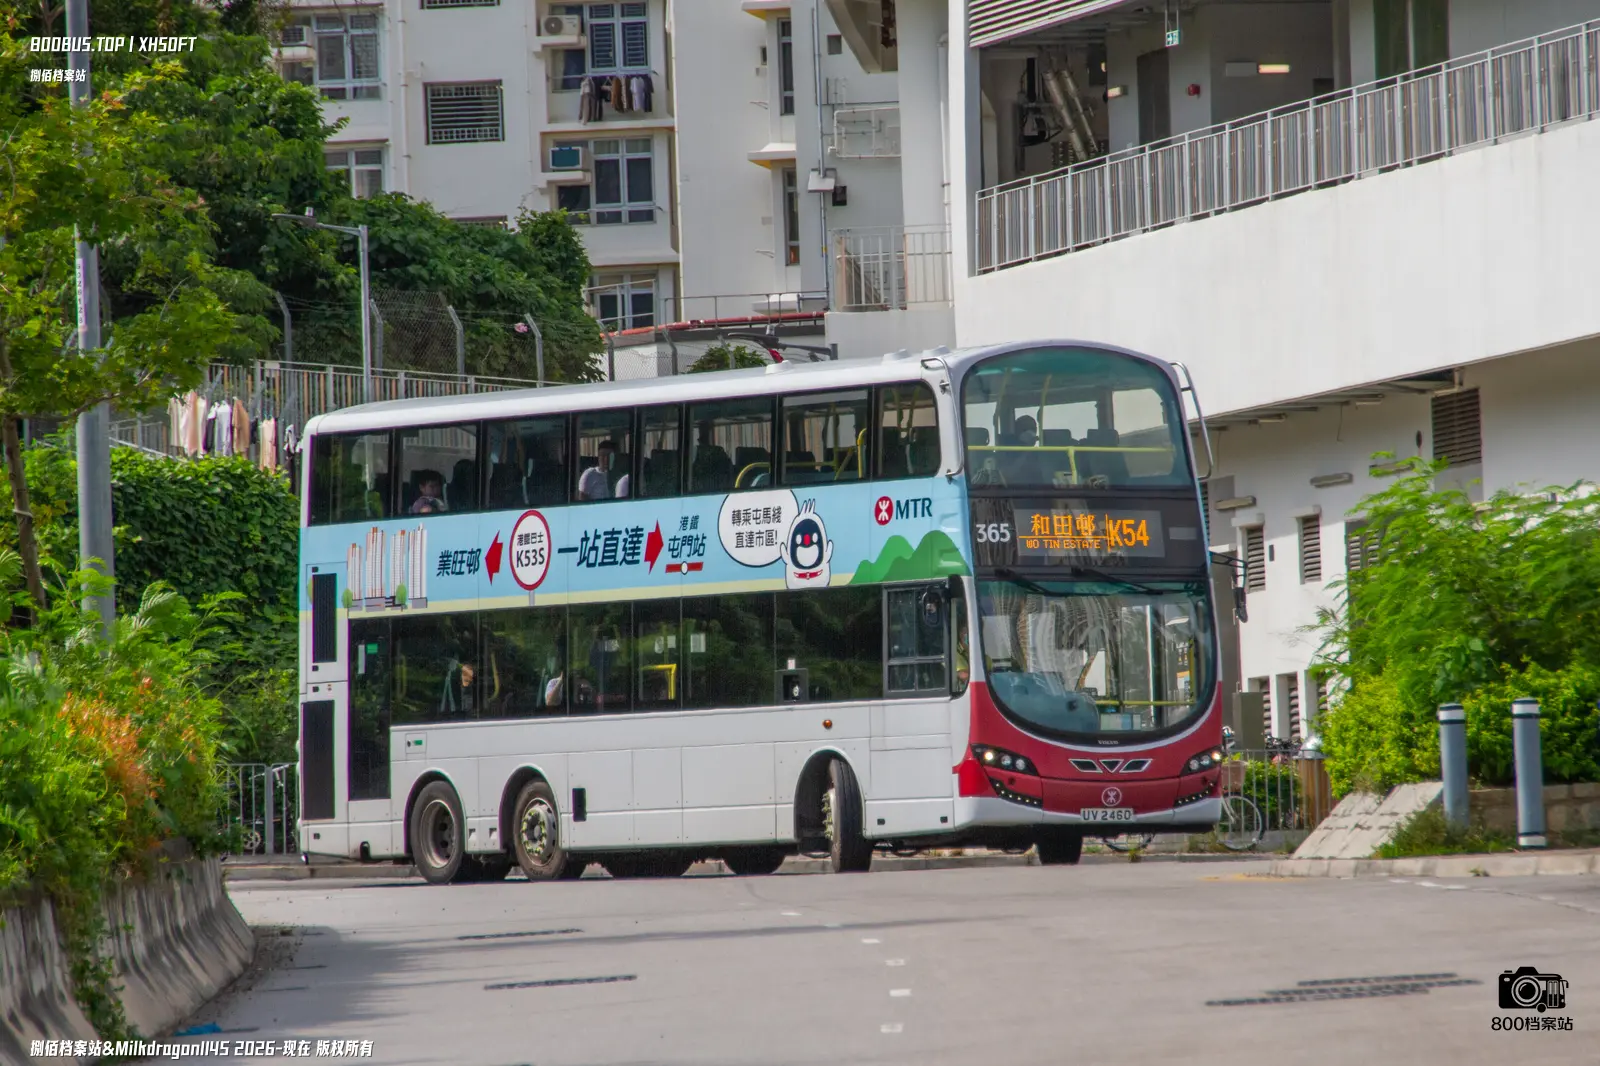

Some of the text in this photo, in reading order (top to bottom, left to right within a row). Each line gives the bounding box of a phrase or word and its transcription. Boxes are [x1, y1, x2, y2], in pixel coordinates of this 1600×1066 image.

[731, 506, 782, 527] 轉乘屯馬綫
[895, 497, 932, 520] MTR
[679, 514, 700, 531] 港鐵
[975, 523, 1011, 543] 365
[1031, 513, 1096, 536] 和田邨
[1109, 519, 1149, 546] K54
[557, 525, 645, 568] 一站直達
[668, 533, 707, 558] 屯門站
[735, 529, 778, 548] 直達市區!
[1026, 539, 1101, 549] WO TIN ESTATE
[436, 548, 482, 577] 業旺邨
[516, 547, 545, 569] K53S
[1083, 810, 1132, 820] UV 2460
